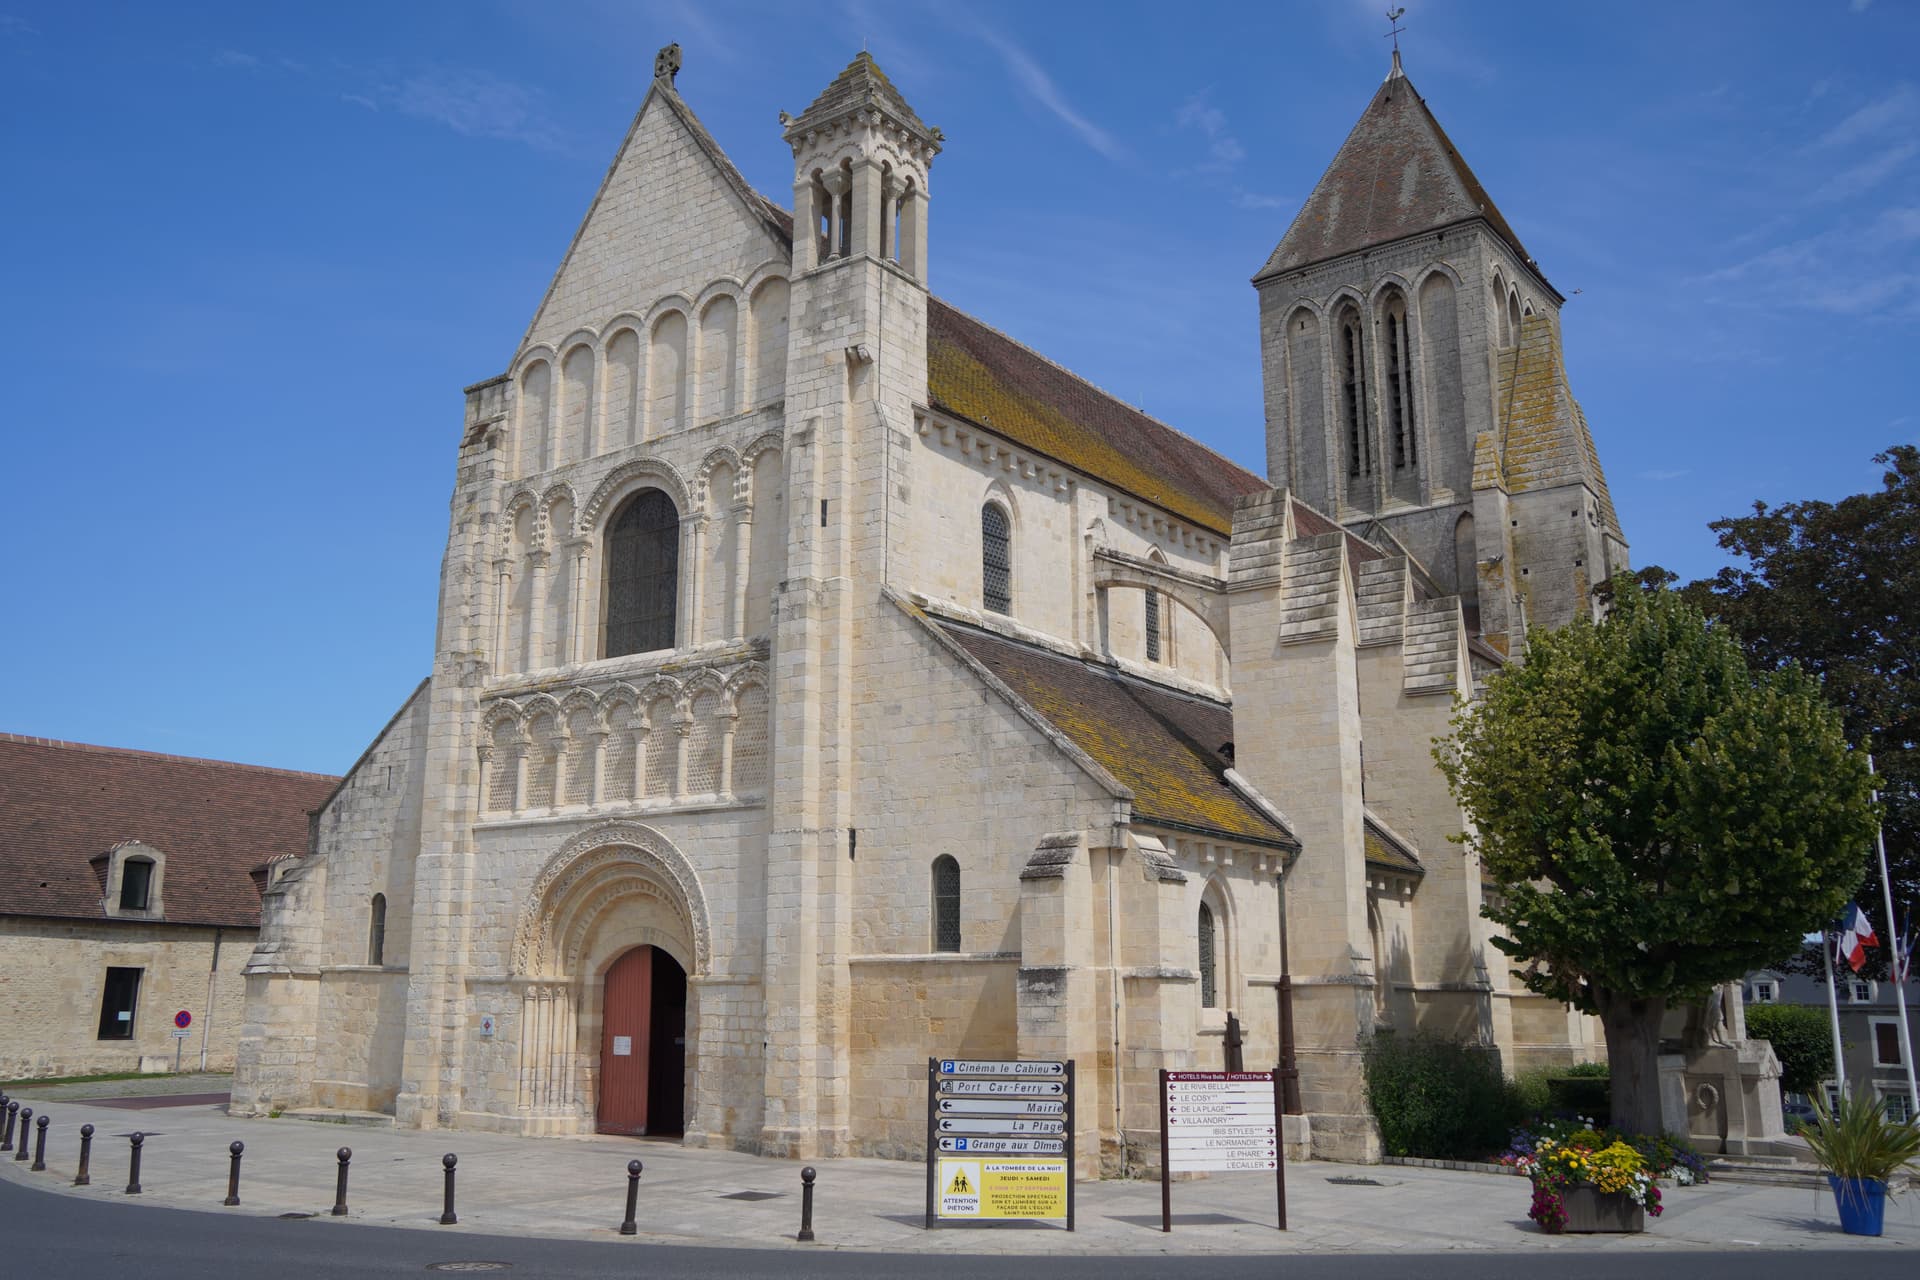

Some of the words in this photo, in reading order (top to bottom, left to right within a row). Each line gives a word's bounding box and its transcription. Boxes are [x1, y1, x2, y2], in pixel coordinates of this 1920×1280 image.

[958, 1063, 995, 1073] Cinéma
[1000, 1064, 1009, 1073] le
[1015, 1064, 1049, 1074] Cabieu
[958, 1082, 981, 1092] Port
[989, 1083, 1043, 1094] Car-Ferry
[1026, 1104, 1063, 1112] Mairie
[1012, 1122, 1024, 1131] La
[1032, 1122, 1063, 1133] Plage
[972, 1140, 1006, 1152] Grange
[1034, 1140, 1063, 1150] Dîmes
